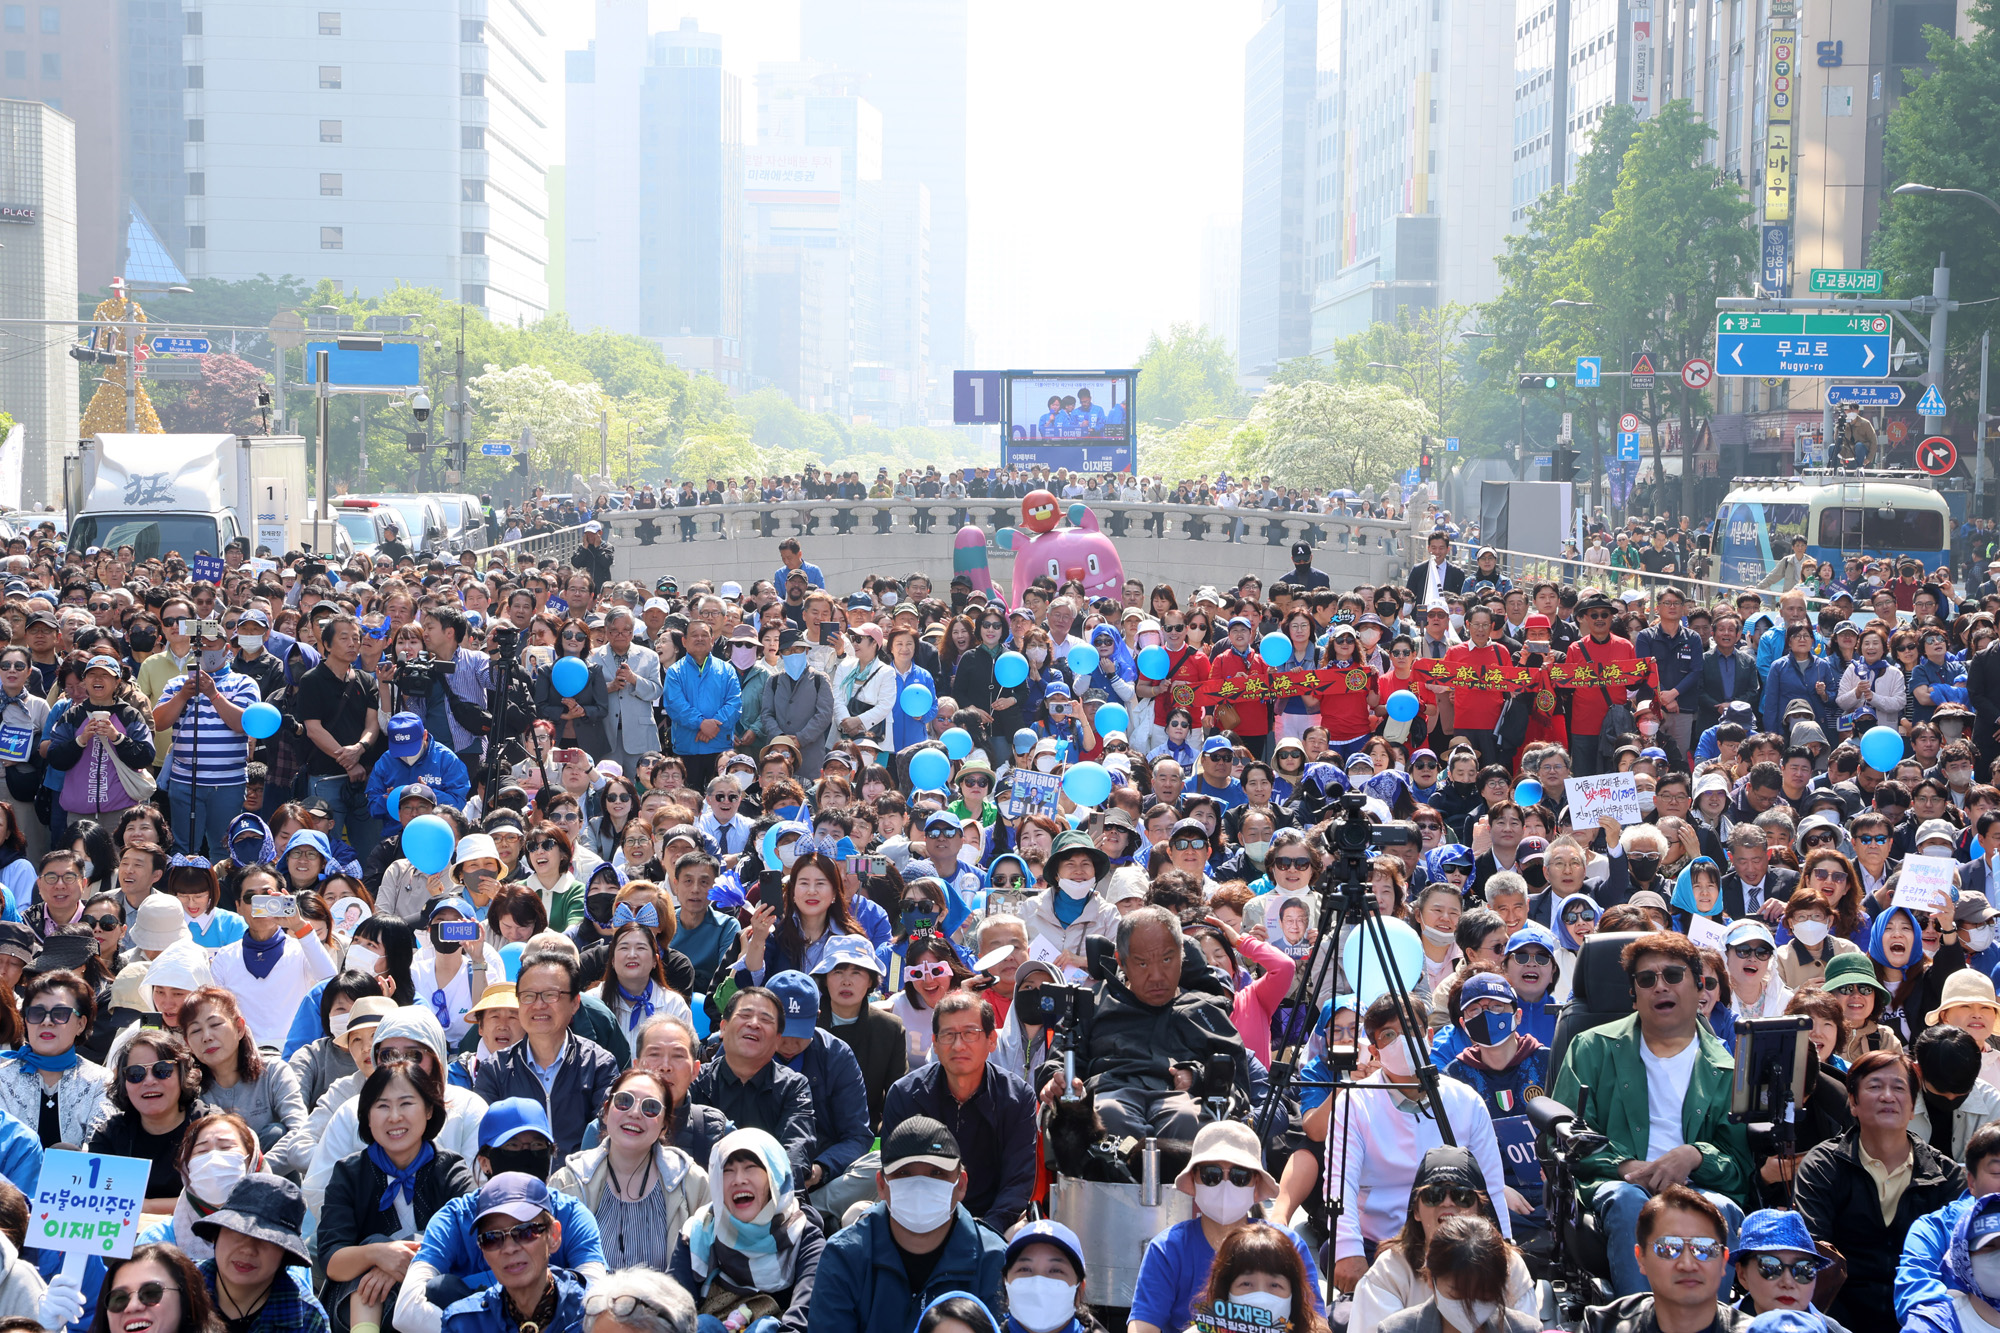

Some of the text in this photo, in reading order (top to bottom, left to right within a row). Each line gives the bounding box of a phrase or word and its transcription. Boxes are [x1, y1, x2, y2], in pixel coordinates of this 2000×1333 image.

[1817, 41, 1842, 67] 딩
[1776, 47, 1788, 106] 당구클럽
[813, 156, 832, 168] 투자
[1769, 136, 1788, 196] 고바우
[748, 170, 815, 182] 미래에셋증권
[4, 208, 35, 217] PLACE
[1765, 245, 1784, 256] 사랑
[1766, 257, 1784, 268] 담은
[1816, 273, 1876, 290] 무교동사거리
[1738, 318, 1870, 331] 광교 시청
[1776, 341, 1829, 357] 무교로
[1780, 361, 1824, 371] Mugyo-ro
[970, 378, 984, 416] 1
[1851, 388, 1877, 396] 무교로
[1889, 392, 1899, 400] 33
[1623, 419, 1634, 428] 30
[1625, 434, 1633, 446] P
[1012, 454, 1036, 462] 이제부터
[1082, 449, 1087, 460] 1
[1083, 461, 1113, 472] 이재명
[123, 472, 175, 506] 狂
[267, 486, 273, 500] 1
[1730, 521, 1759, 546] 서울의소리
[197, 559, 221, 569] 기호 1번
[1737, 561, 1762, 583] 이동스튜디오
[549, 599, 560, 609] 기호
[1429, 662, 1532, 684] 無敵海兵
[1550, 661, 1648, 680] 無敵海兵
[1218, 672, 1320, 696] 無敵海兵
[1015, 770, 1060, 788] 함께해야
[1612, 787, 1636, 802] 이재명
[1011, 800, 1054, 819] 합니다
[1900, 885, 1926, 896] 우리가
[914, 918, 932, 928] 독도
[446, 925, 473, 936] 이재명
[912, 926, 936, 937] 지킴이
[1487, 983, 1504, 992] INTER
[788, 998, 801, 1014] LA
[71, 1157, 113, 1191] 기 1 호
[40, 1189, 136, 1218] 더불어민주당
[1973, 1215, 2000, 1234] 민주
[44, 1219, 121, 1251] 이재명
[1214, 1300, 1272, 1326] 이재명
